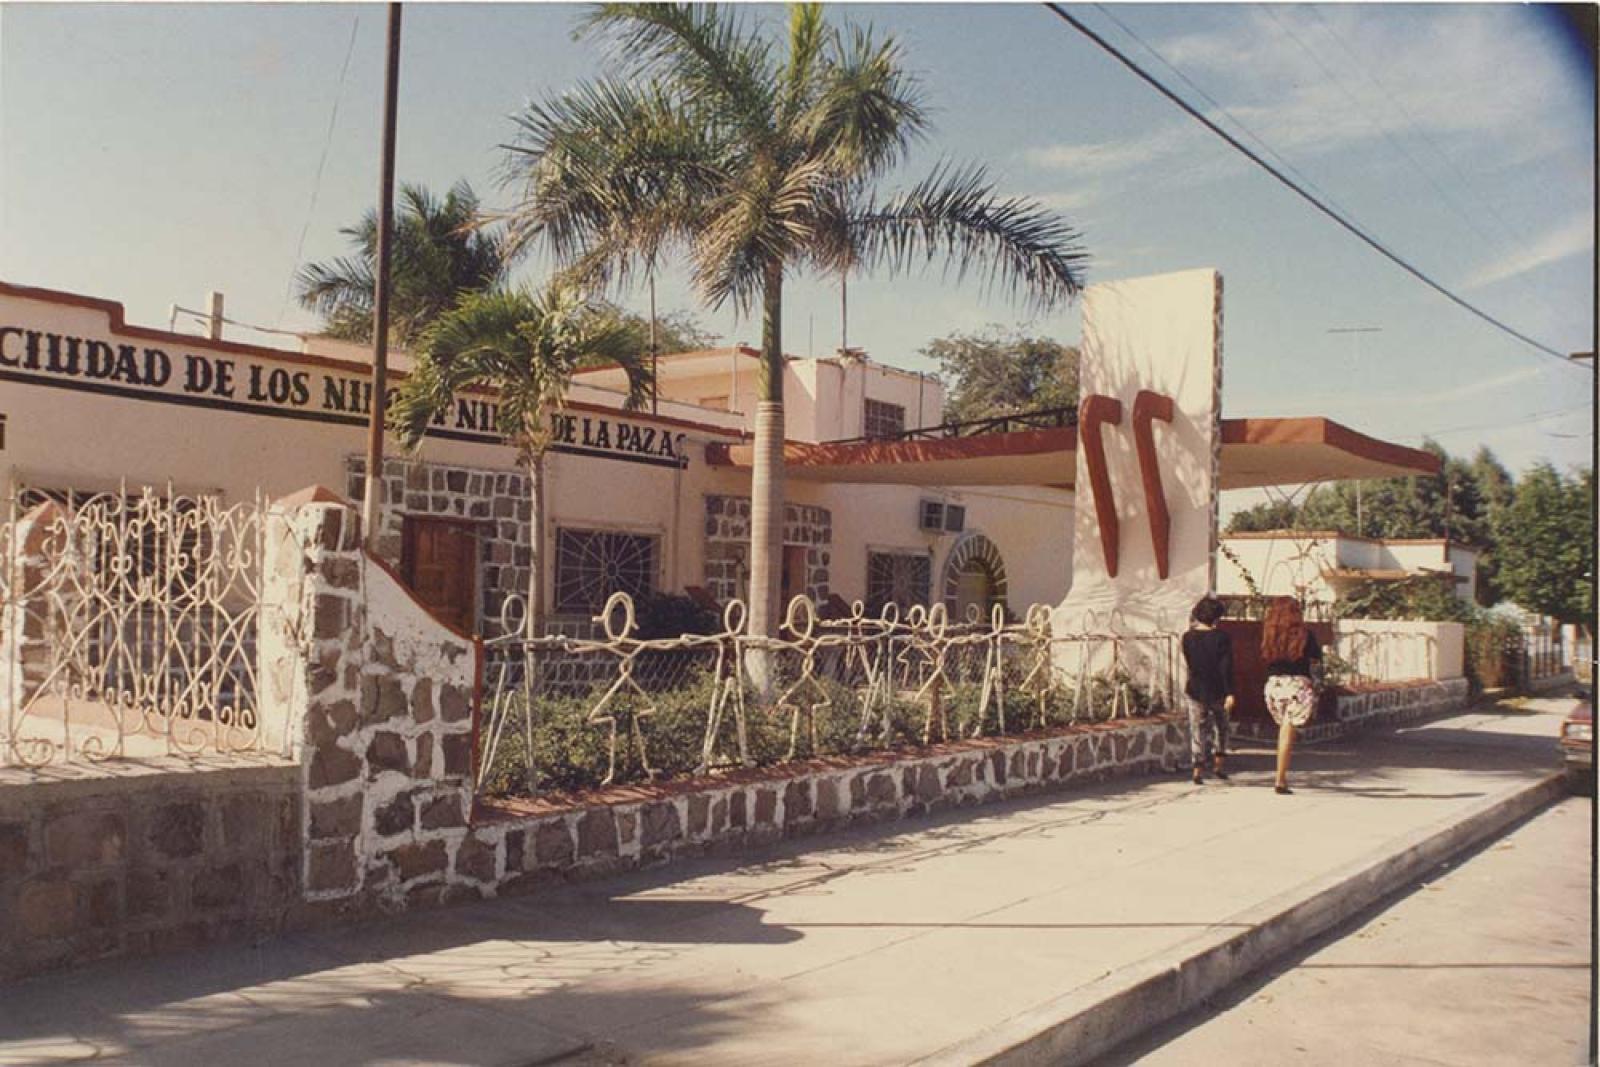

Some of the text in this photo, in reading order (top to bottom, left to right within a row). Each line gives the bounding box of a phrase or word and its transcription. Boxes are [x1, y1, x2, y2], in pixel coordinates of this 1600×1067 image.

[0, 326, 171, 387] CIUDAD
[184, 354, 235, 399] DE
[248, 364, 309, 406] LOS
[551, 412, 577, 443] DE
[582, 418, 611, 449] LA
[616, 422, 656, 454] PAZ
